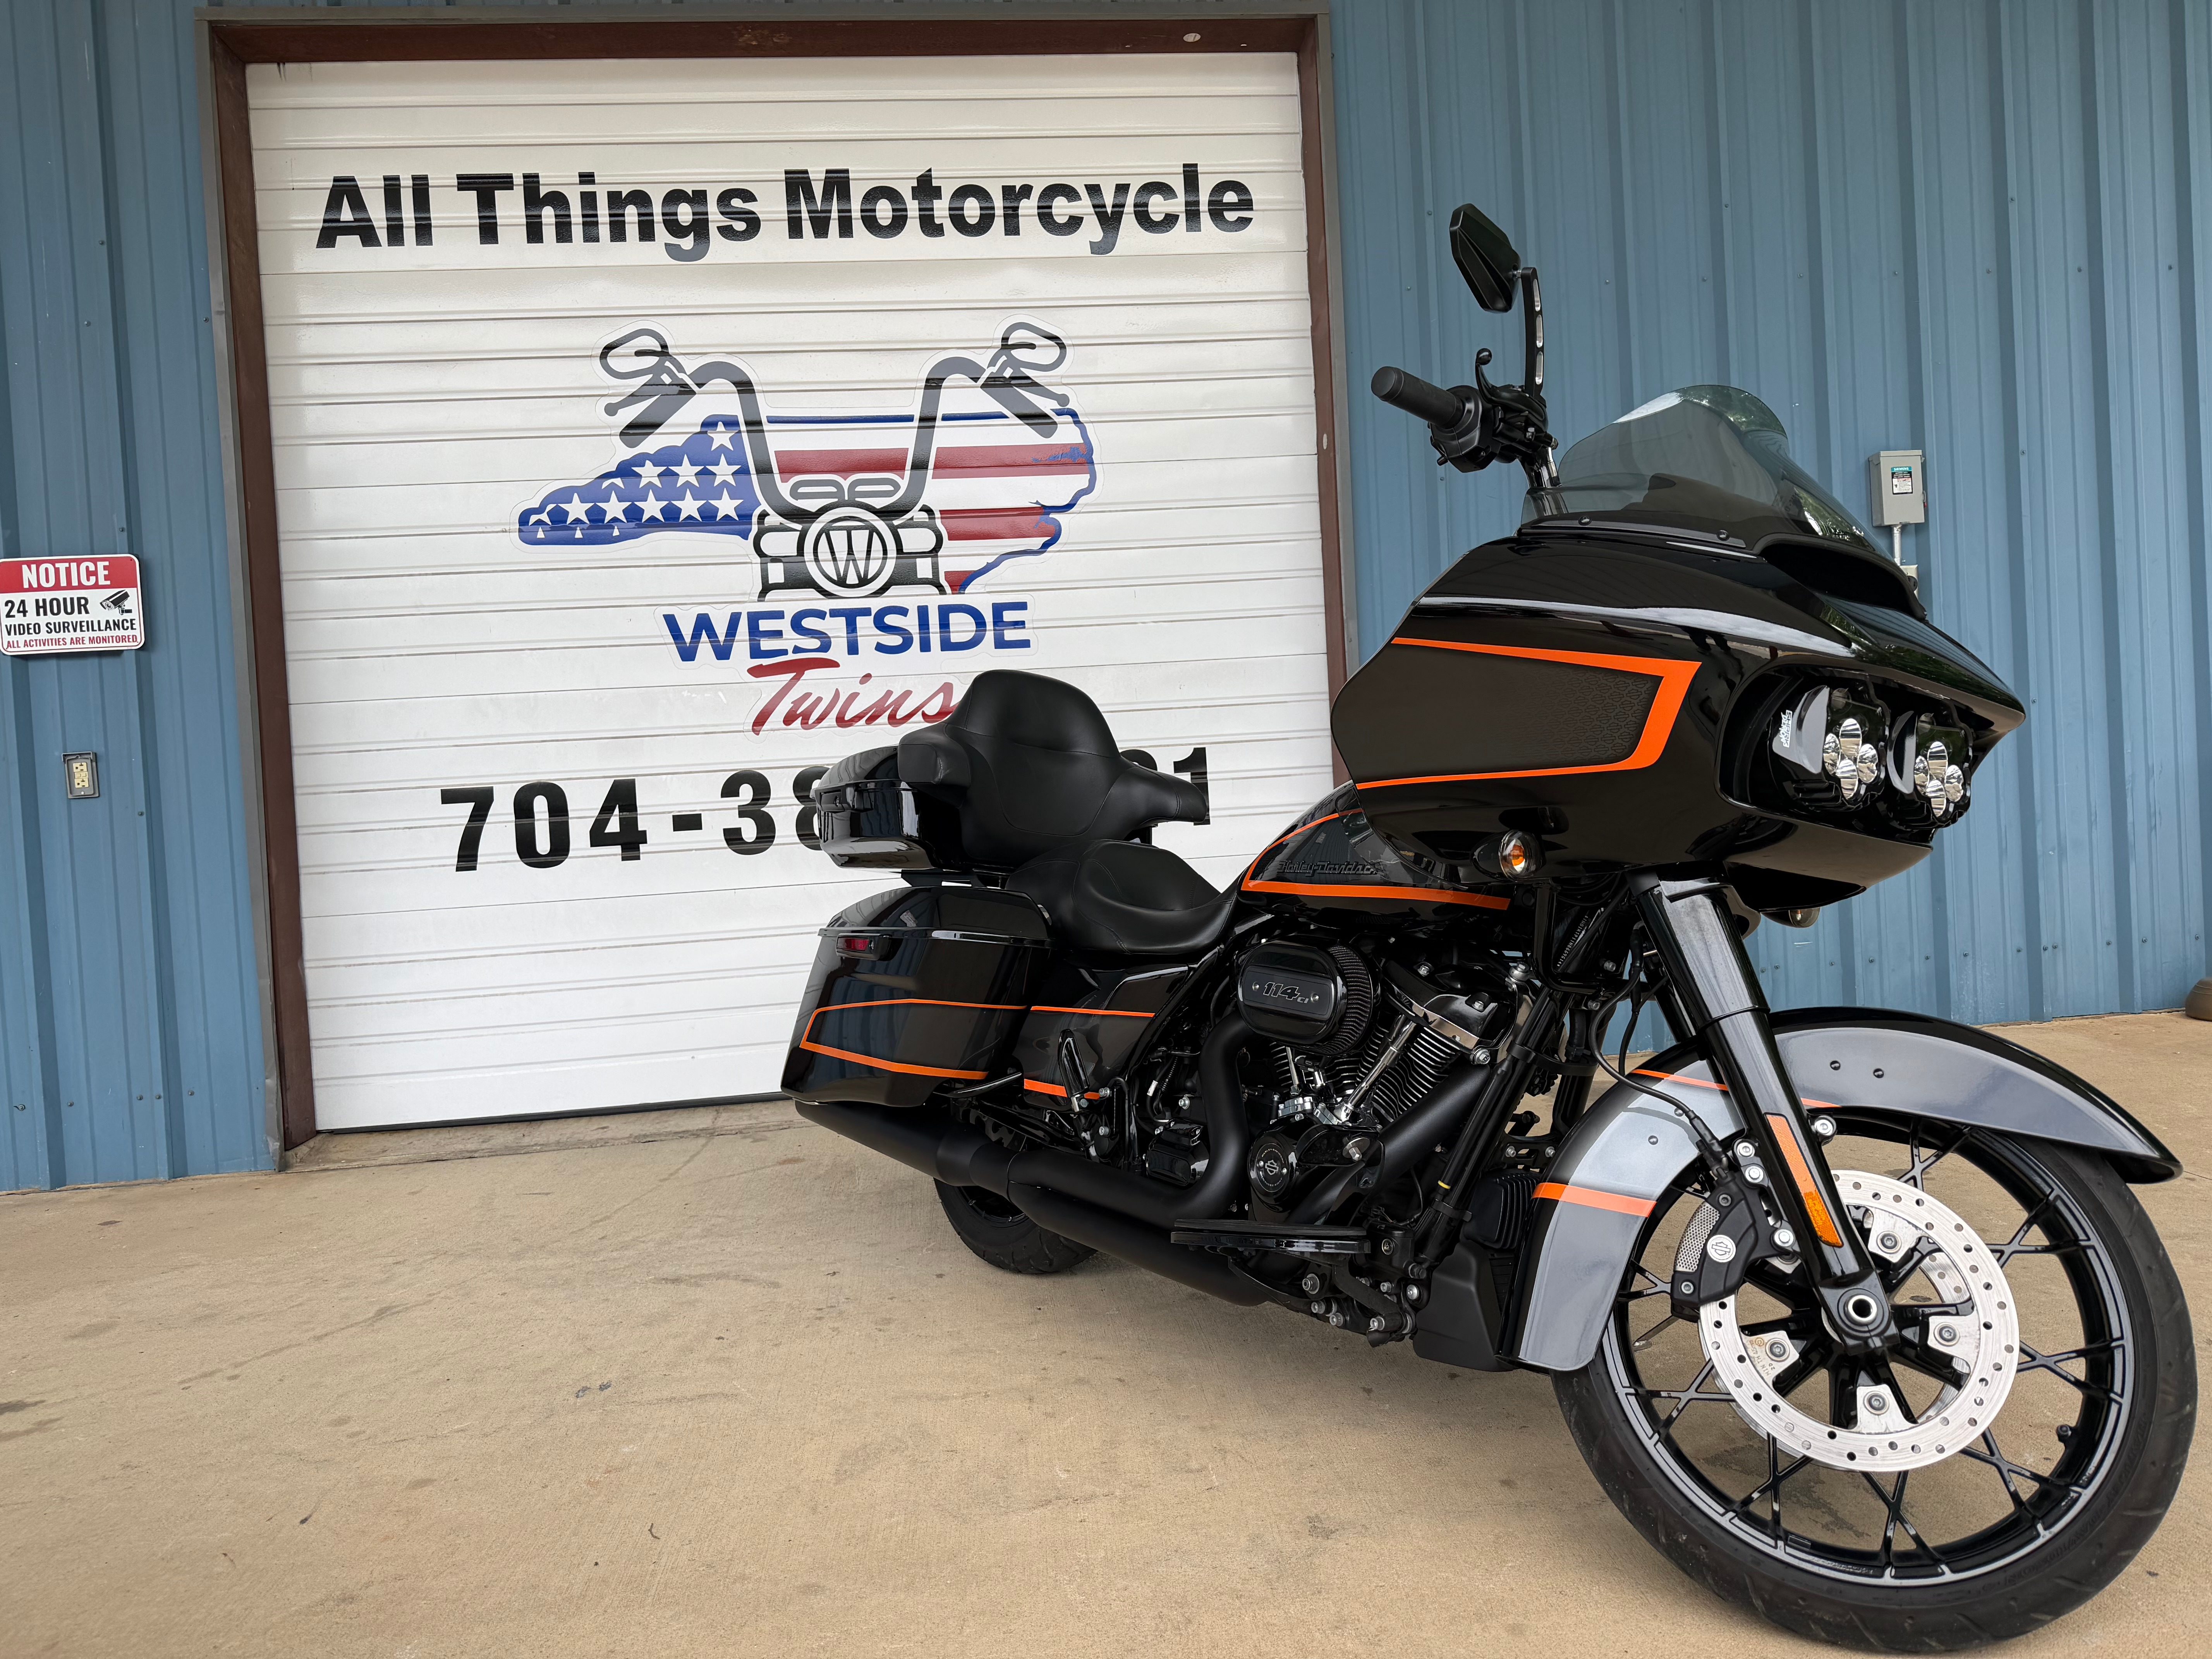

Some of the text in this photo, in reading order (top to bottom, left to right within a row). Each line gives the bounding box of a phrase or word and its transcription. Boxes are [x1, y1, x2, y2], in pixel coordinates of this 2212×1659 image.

[316, 163, 1254, 262] All Things Motorcycle
[22, 561, 111, 588] NOTICE
[5, 596, 90, 618] 24 HOUR
[5, 618, 137, 636] VIDEO SURVEILLANCE
[663, 601, 1031, 662] WESTSIDE
[7, 641, 21, 649] ALL
[24, 637, 67, 647] ACTIVITIES
[70, 637, 86, 645] ARE
[747, 657, 958, 736] Twins
[1263, 982, 1300, 1000] 114
[1760, 1364, 1771, 1376] MIN
